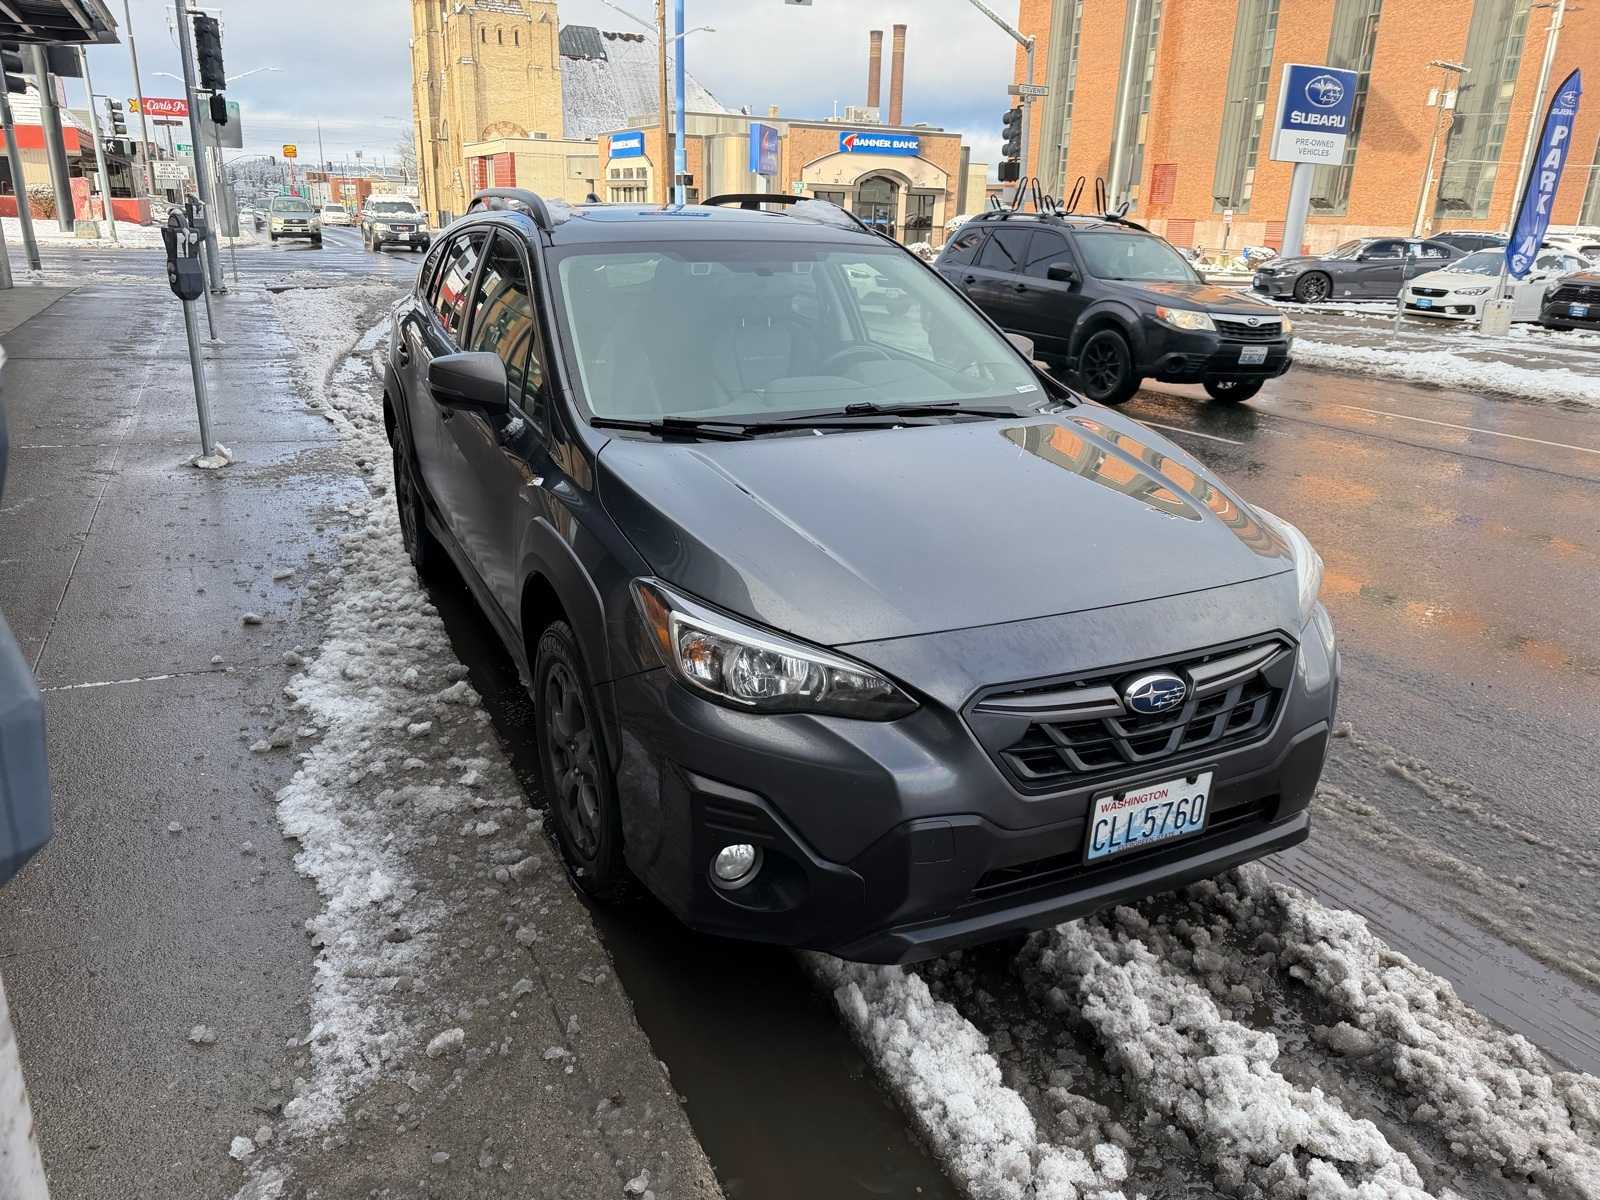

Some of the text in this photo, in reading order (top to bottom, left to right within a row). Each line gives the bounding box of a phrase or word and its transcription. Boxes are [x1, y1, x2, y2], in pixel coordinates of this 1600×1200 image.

[1290, 110, 1346, 128] SUBARU
[853, 138, 918, 150] BANNER BANK
[1295, 137, 1335, 149] PRE-OWNED
[1298, 147, 1330, 157] VEHICLES
[1511, 125, 1568, 273] PARKING
[1100, 788, 1169, 813] WASHINGTON
[1092, 793, 1205, 852] CLL5760
